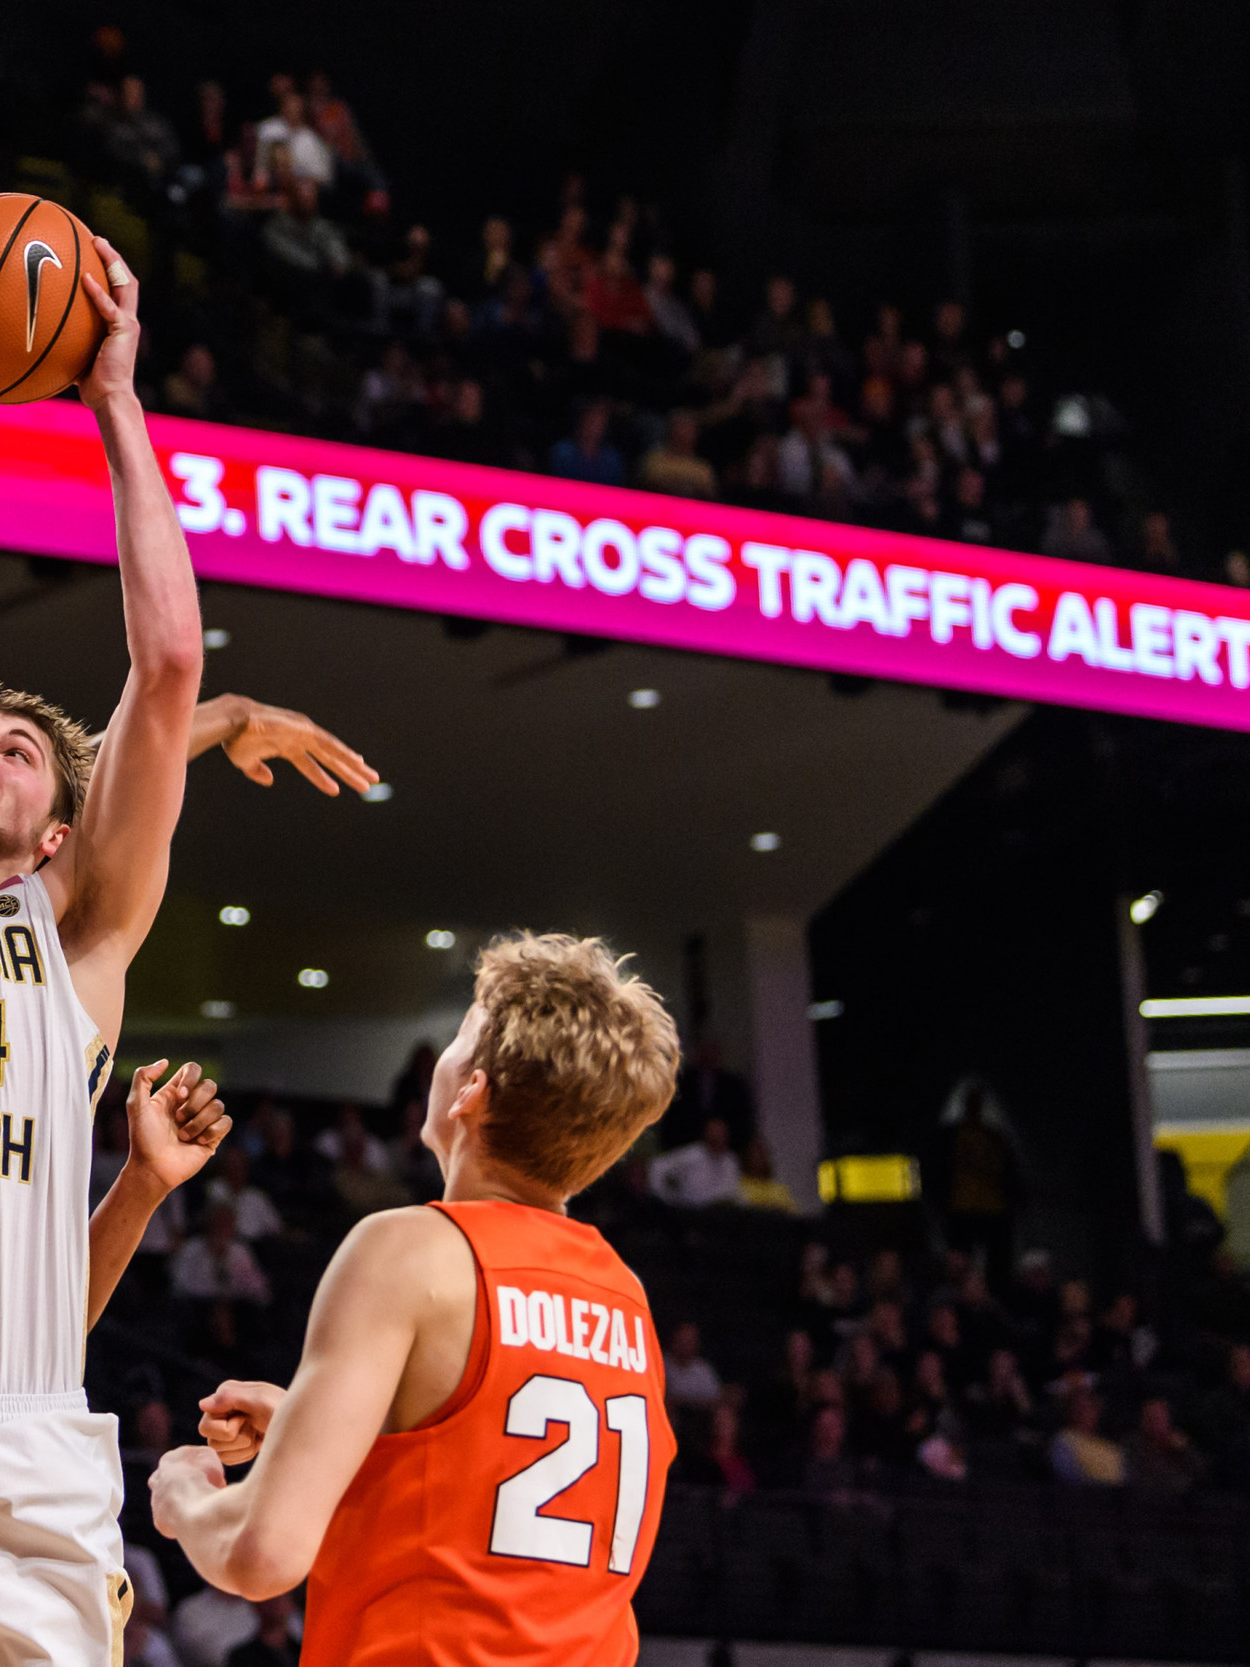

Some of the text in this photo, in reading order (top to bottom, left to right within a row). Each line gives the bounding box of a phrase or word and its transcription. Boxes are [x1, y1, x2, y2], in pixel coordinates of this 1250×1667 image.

[170, 452, 1250, 689] 3. REAR CROSS TRAFFIC ALERT
[497, 1285, 647, 1374] DOLEZAJ
[488, 1373, 650, 1576] 21
